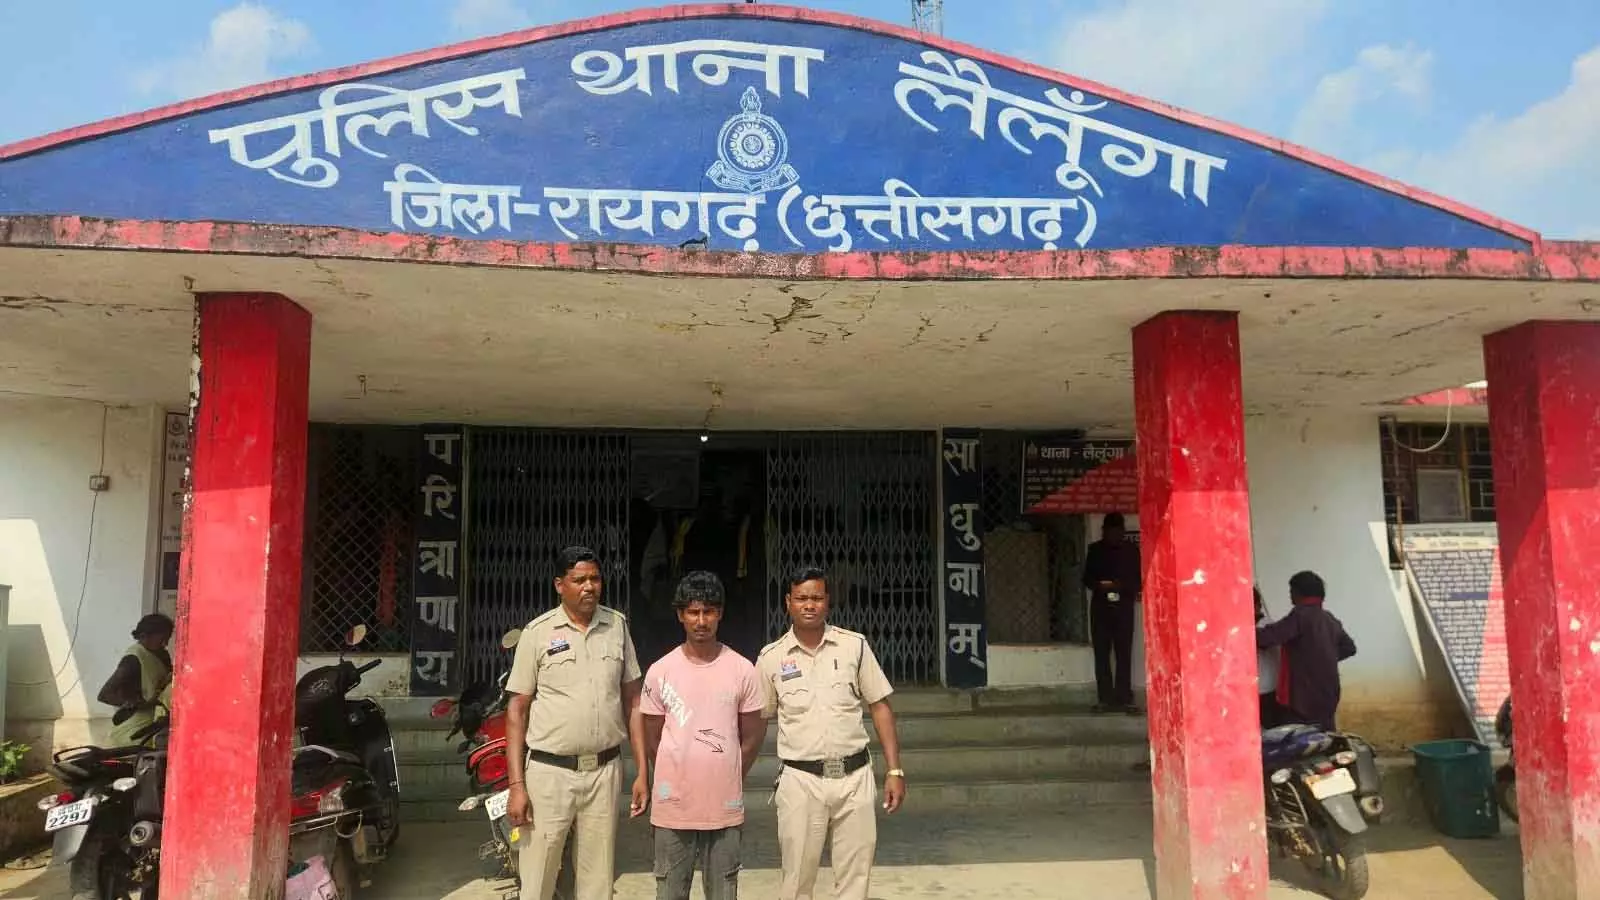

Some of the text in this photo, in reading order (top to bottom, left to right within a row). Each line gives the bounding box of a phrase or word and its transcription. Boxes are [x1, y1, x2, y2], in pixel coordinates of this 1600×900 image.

[208, 39, 1227, 205] पुलिस थाना लैलूँगा
[1040, 446, 1071, 460] थाना
[47, 809, 89, 829] 2297
